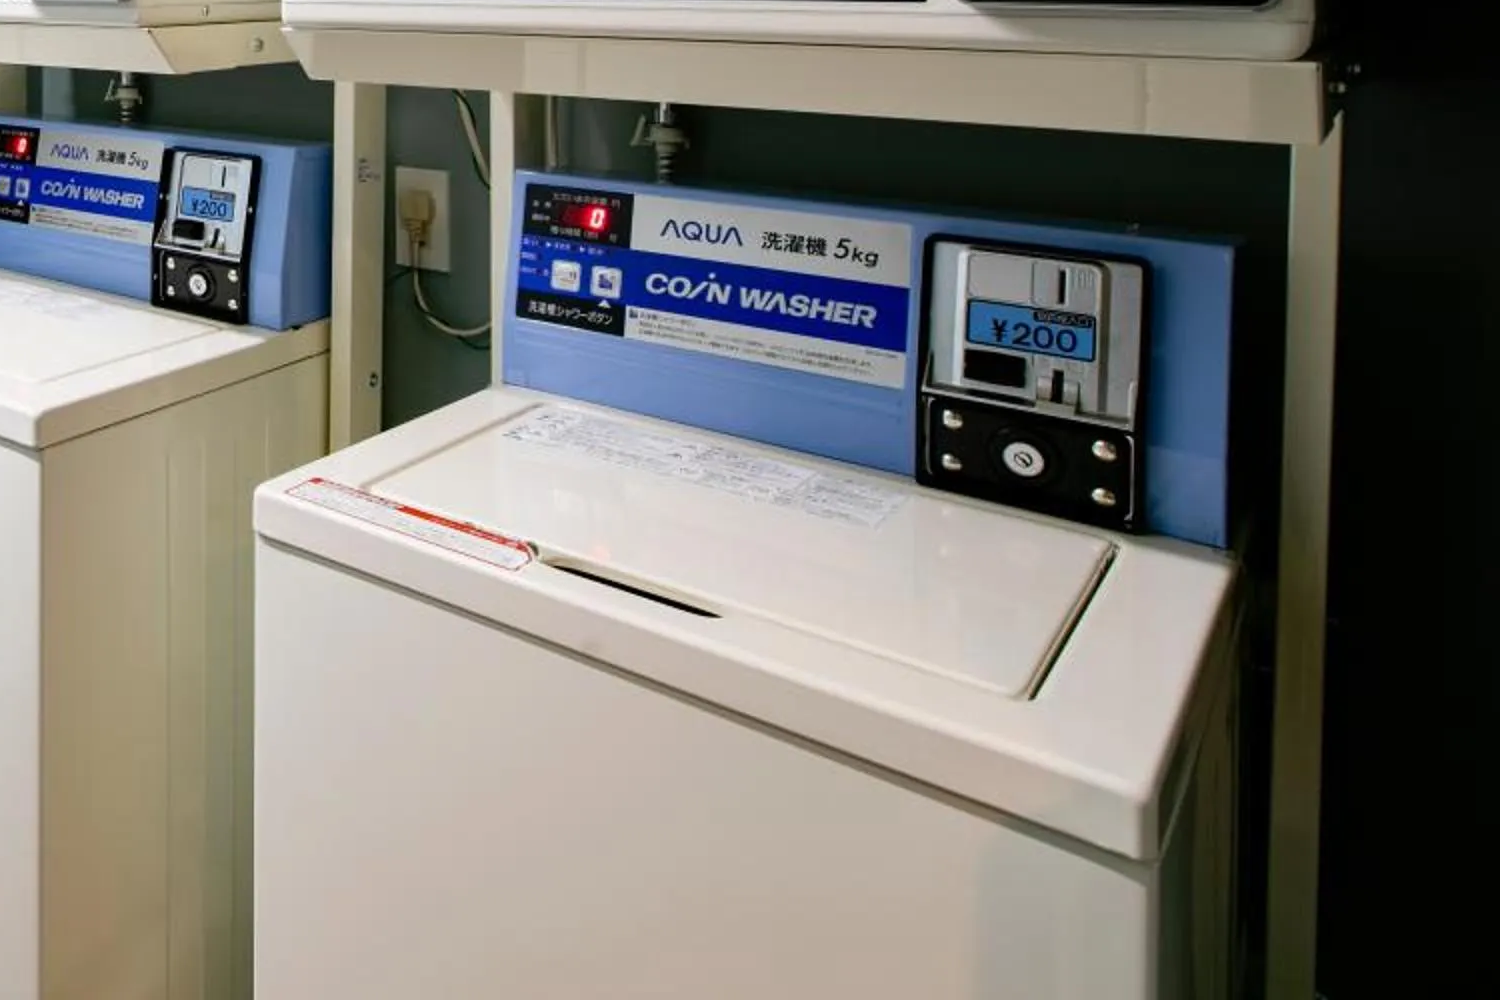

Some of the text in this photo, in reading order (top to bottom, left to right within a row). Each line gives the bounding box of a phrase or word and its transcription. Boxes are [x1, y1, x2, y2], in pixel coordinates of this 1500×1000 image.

[50, 143, 89, 160] AQUA
[128, 151, 149, 170] 5kg
[83, 186, 145, 209] WASHER
[192, 199, 227, 216] ¥200
[589, 208, 606, 228] 0
[661, 218, 879, 268] AQUA 洗濯機 5kg
[740, 286, 878, 330] WASHER
[992, 317, 1077, 353] ¥200
